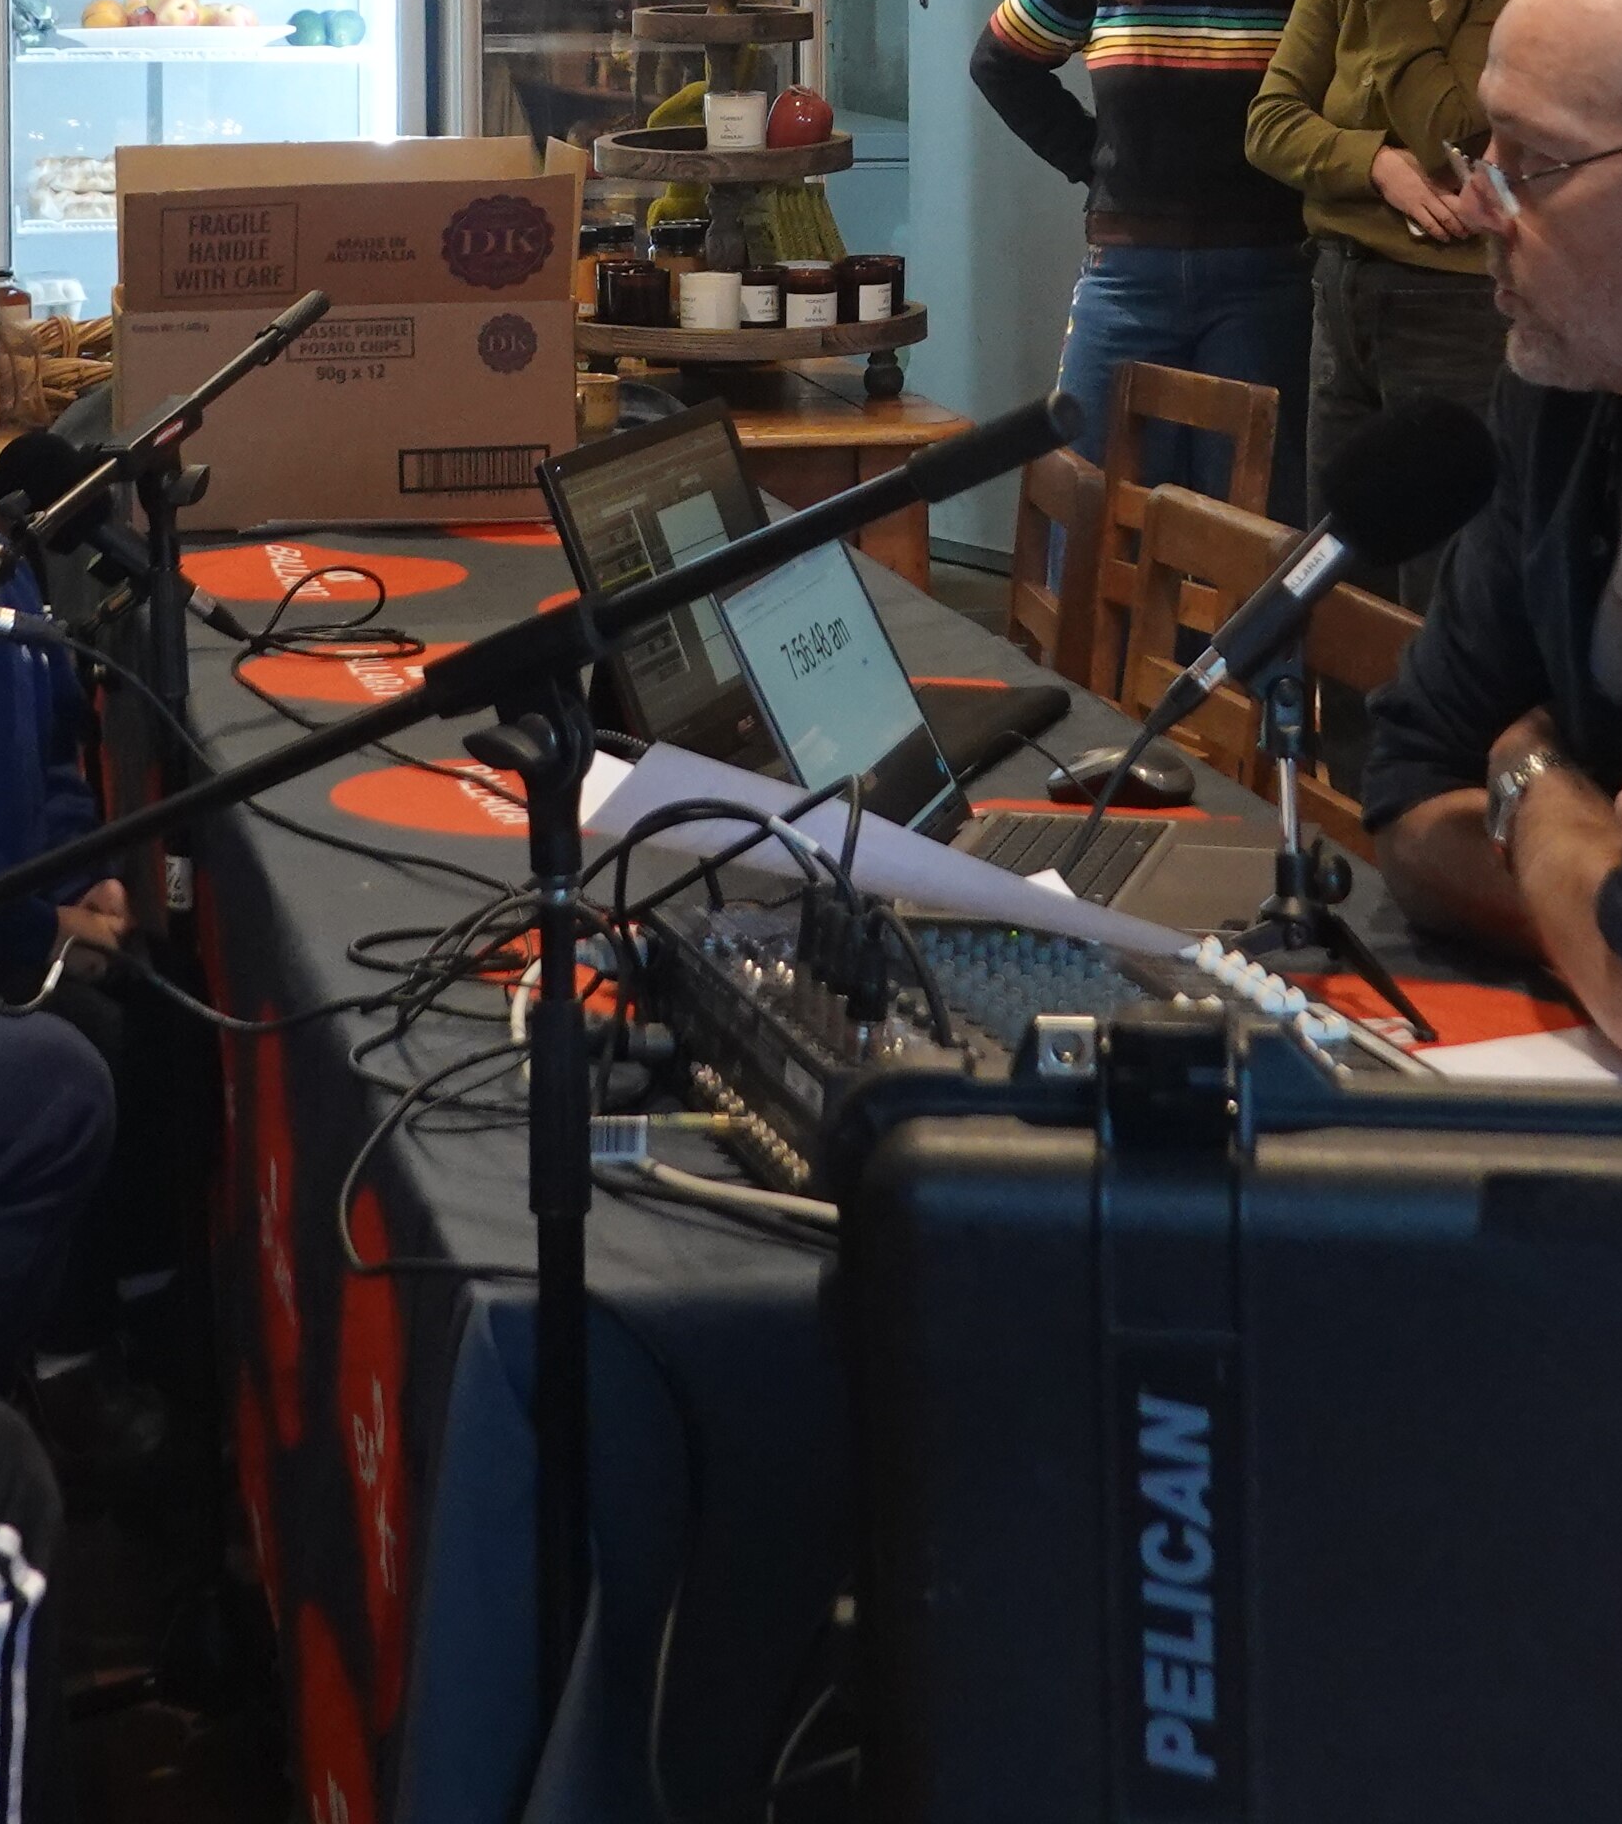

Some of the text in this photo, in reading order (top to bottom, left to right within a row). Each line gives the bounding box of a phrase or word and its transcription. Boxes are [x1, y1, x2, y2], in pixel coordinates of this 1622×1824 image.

[188, 210, 271, 236] FRAGILE
[188, 238, 270, 263] HANDLE
[336, 236, 407, 249] MADE IN
[462, 228, 538, 255] DK
[325, 249, 416, 264] AUSTRALIA
[175, 265, 285, 290] WITH CARE
[300, 323, 410, 339] LASSIC PURPLE
[300, 339, 401, 356] POTATO CHIPS
[316, 364, 386, 384] 90g x 12
[779, 616, 852, 680] 7:56:48 am
[1136, 1390, 1218, 1782] PELICAN
